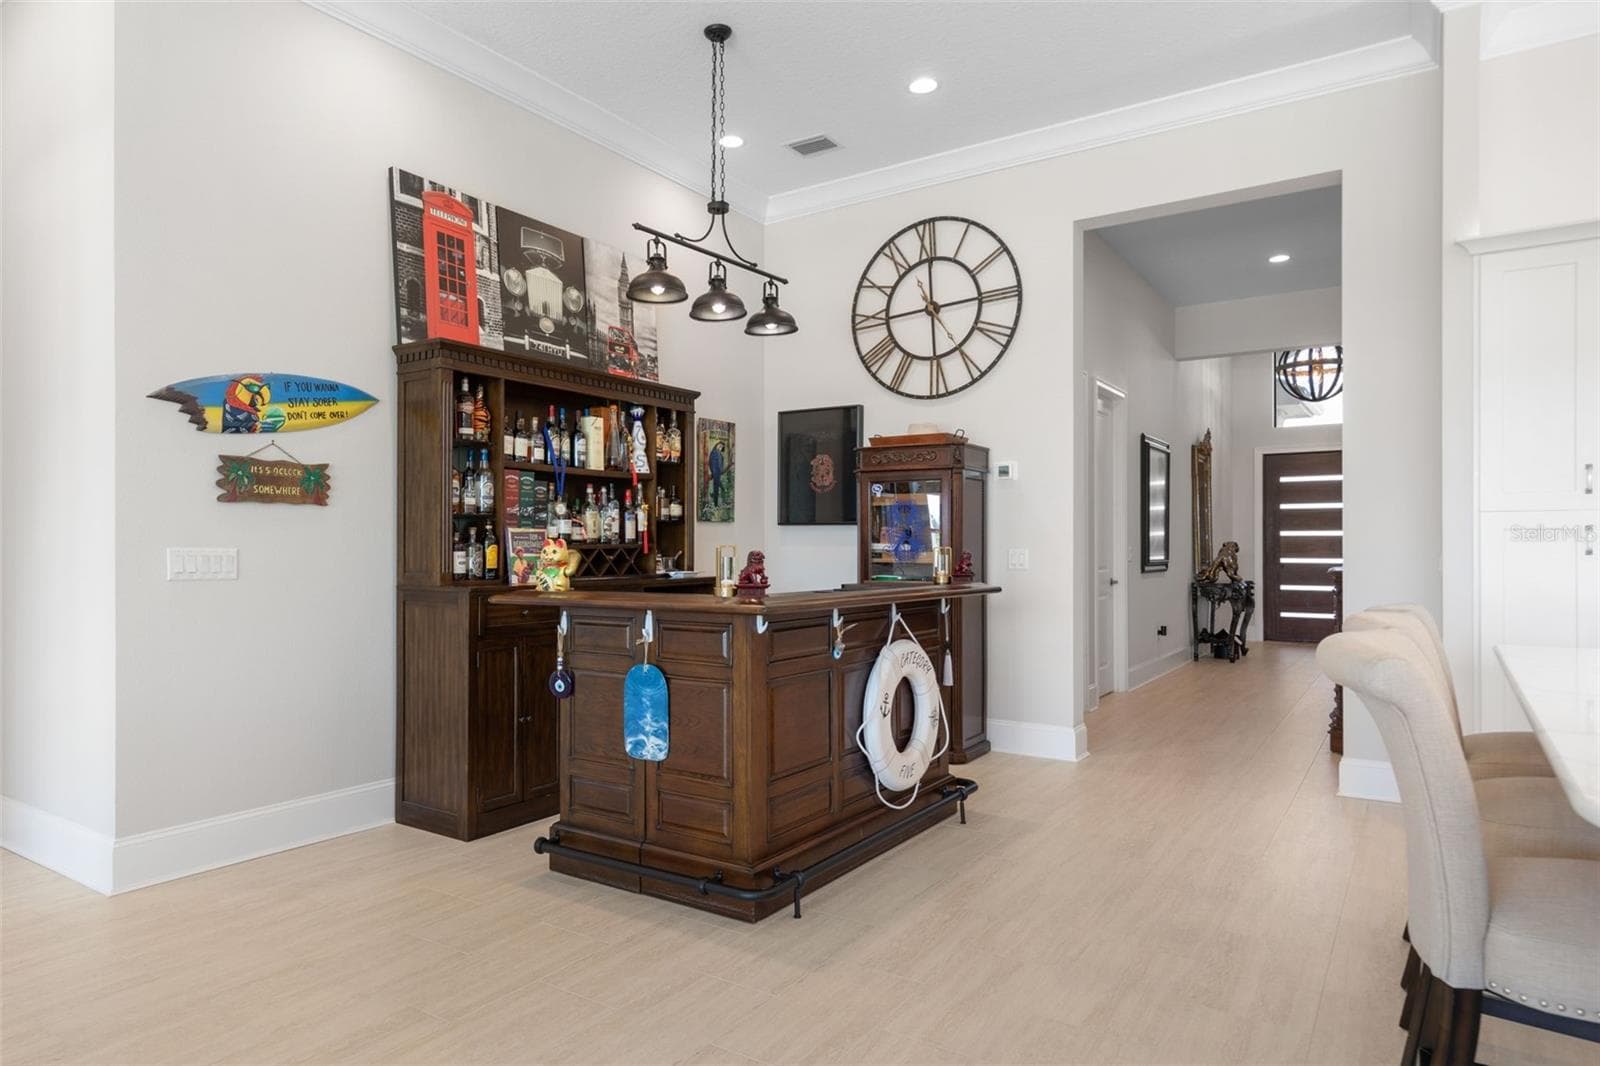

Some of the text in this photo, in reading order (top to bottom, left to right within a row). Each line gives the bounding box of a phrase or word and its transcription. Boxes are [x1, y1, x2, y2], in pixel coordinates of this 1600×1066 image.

[284, 381, 339, 393] IF YOU WANNA
[288, 397, 338, 408] STAY SOBER
[309, 411, 327, 420] COME
[253, 484, 301, 496] SOMEWHERE
[901, 650, 932, 674] CATEGORY
[899, 761, 916, 778] FIVE
